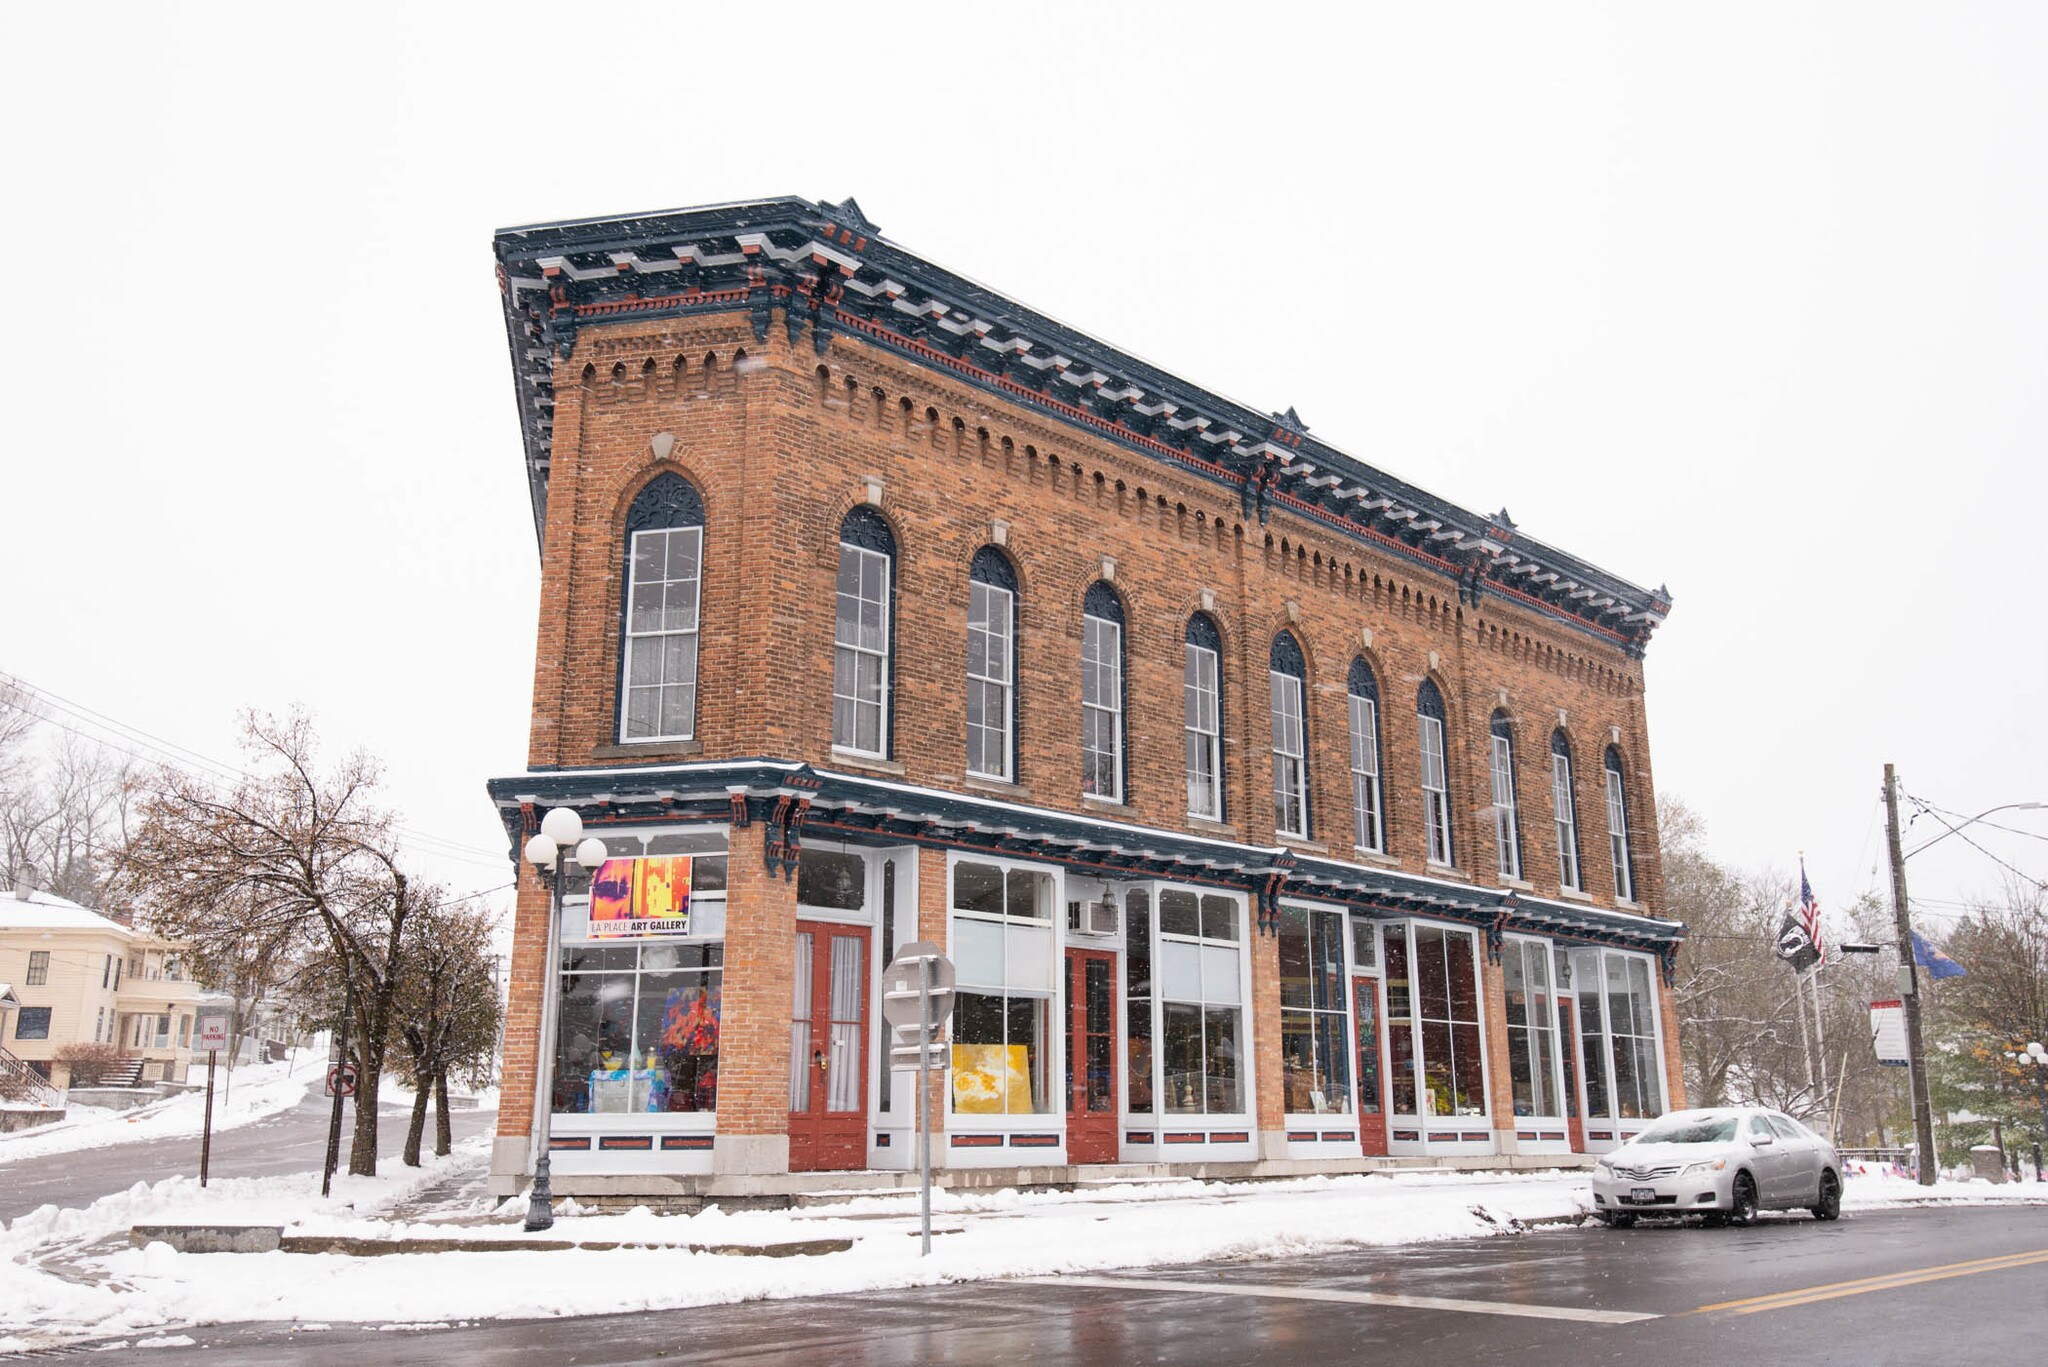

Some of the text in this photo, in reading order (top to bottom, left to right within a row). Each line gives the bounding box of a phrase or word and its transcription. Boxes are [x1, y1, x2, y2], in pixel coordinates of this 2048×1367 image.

[591, 920, 687, 932] LA PLACE ART GALLERY
